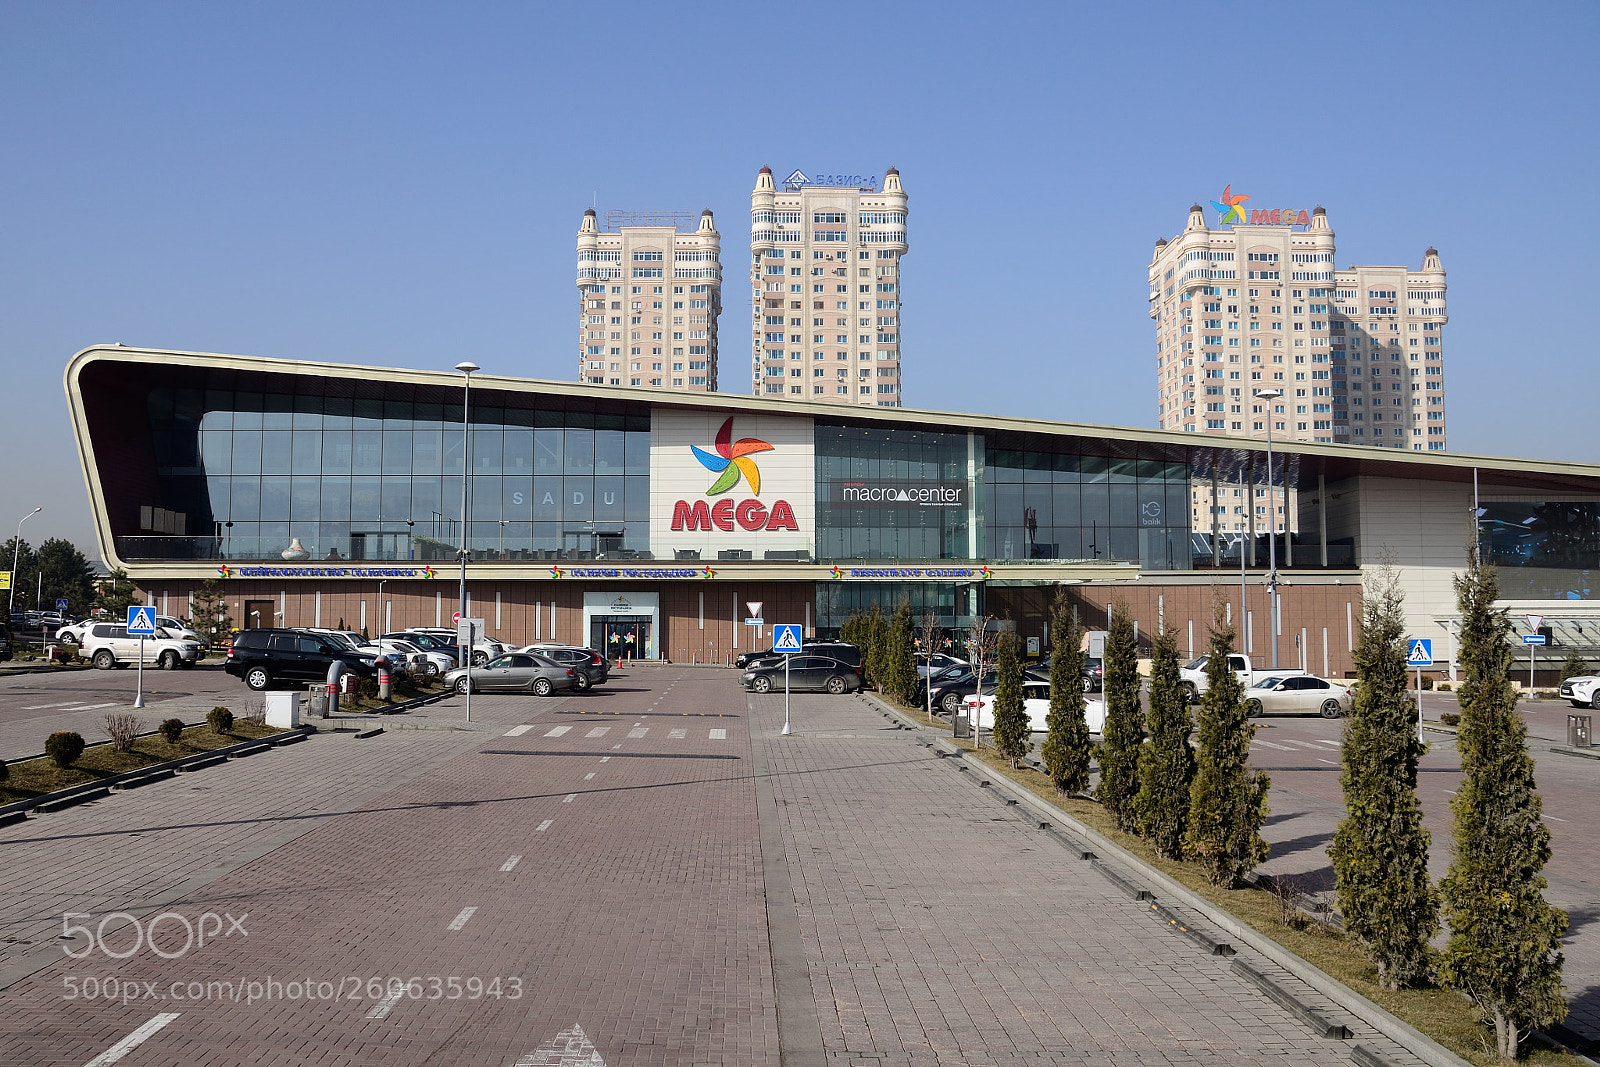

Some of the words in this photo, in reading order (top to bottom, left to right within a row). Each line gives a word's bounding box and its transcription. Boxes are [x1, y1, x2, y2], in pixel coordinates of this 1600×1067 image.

[816, 174, 878, 186] БАЗИС-А
[1250, 208, 1311, 225] MEGA
[512, 491, 615, 505] SADU
[671, 498, 798, 532] MEGA
[850, 568, 920, 577] RESTAURANT
[925, 568, 972, 577] GALLERY
